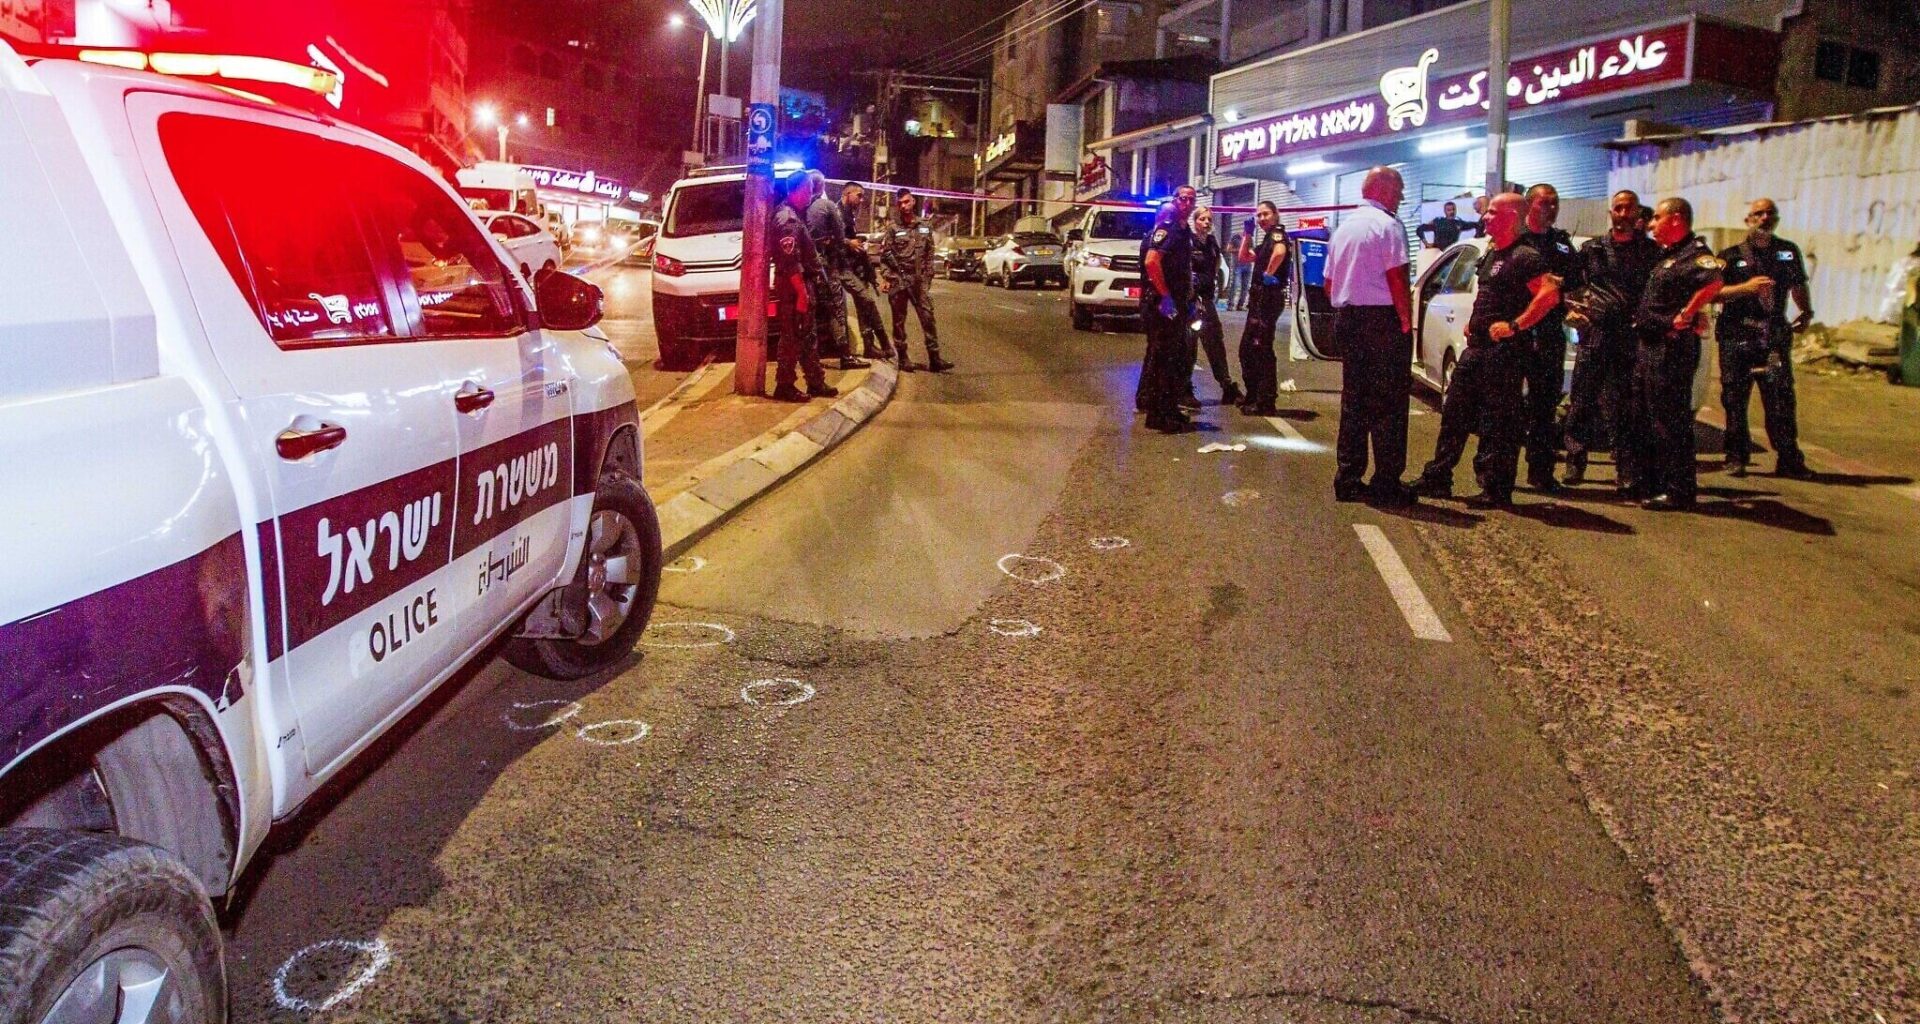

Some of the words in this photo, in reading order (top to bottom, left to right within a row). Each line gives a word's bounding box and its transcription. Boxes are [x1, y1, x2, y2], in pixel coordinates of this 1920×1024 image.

[1525, 47, 1596, 104] الدين
[1599, 35, 1669, 79] علاء
[1438, 70, 1523, 110] مكت
[1320, 101, 1375, 137] עלאא
[474, 441, 558, 525] משטרת
[317, 491, 441, 606] ישראל
[478, 535, 530, 595] الشرطة
